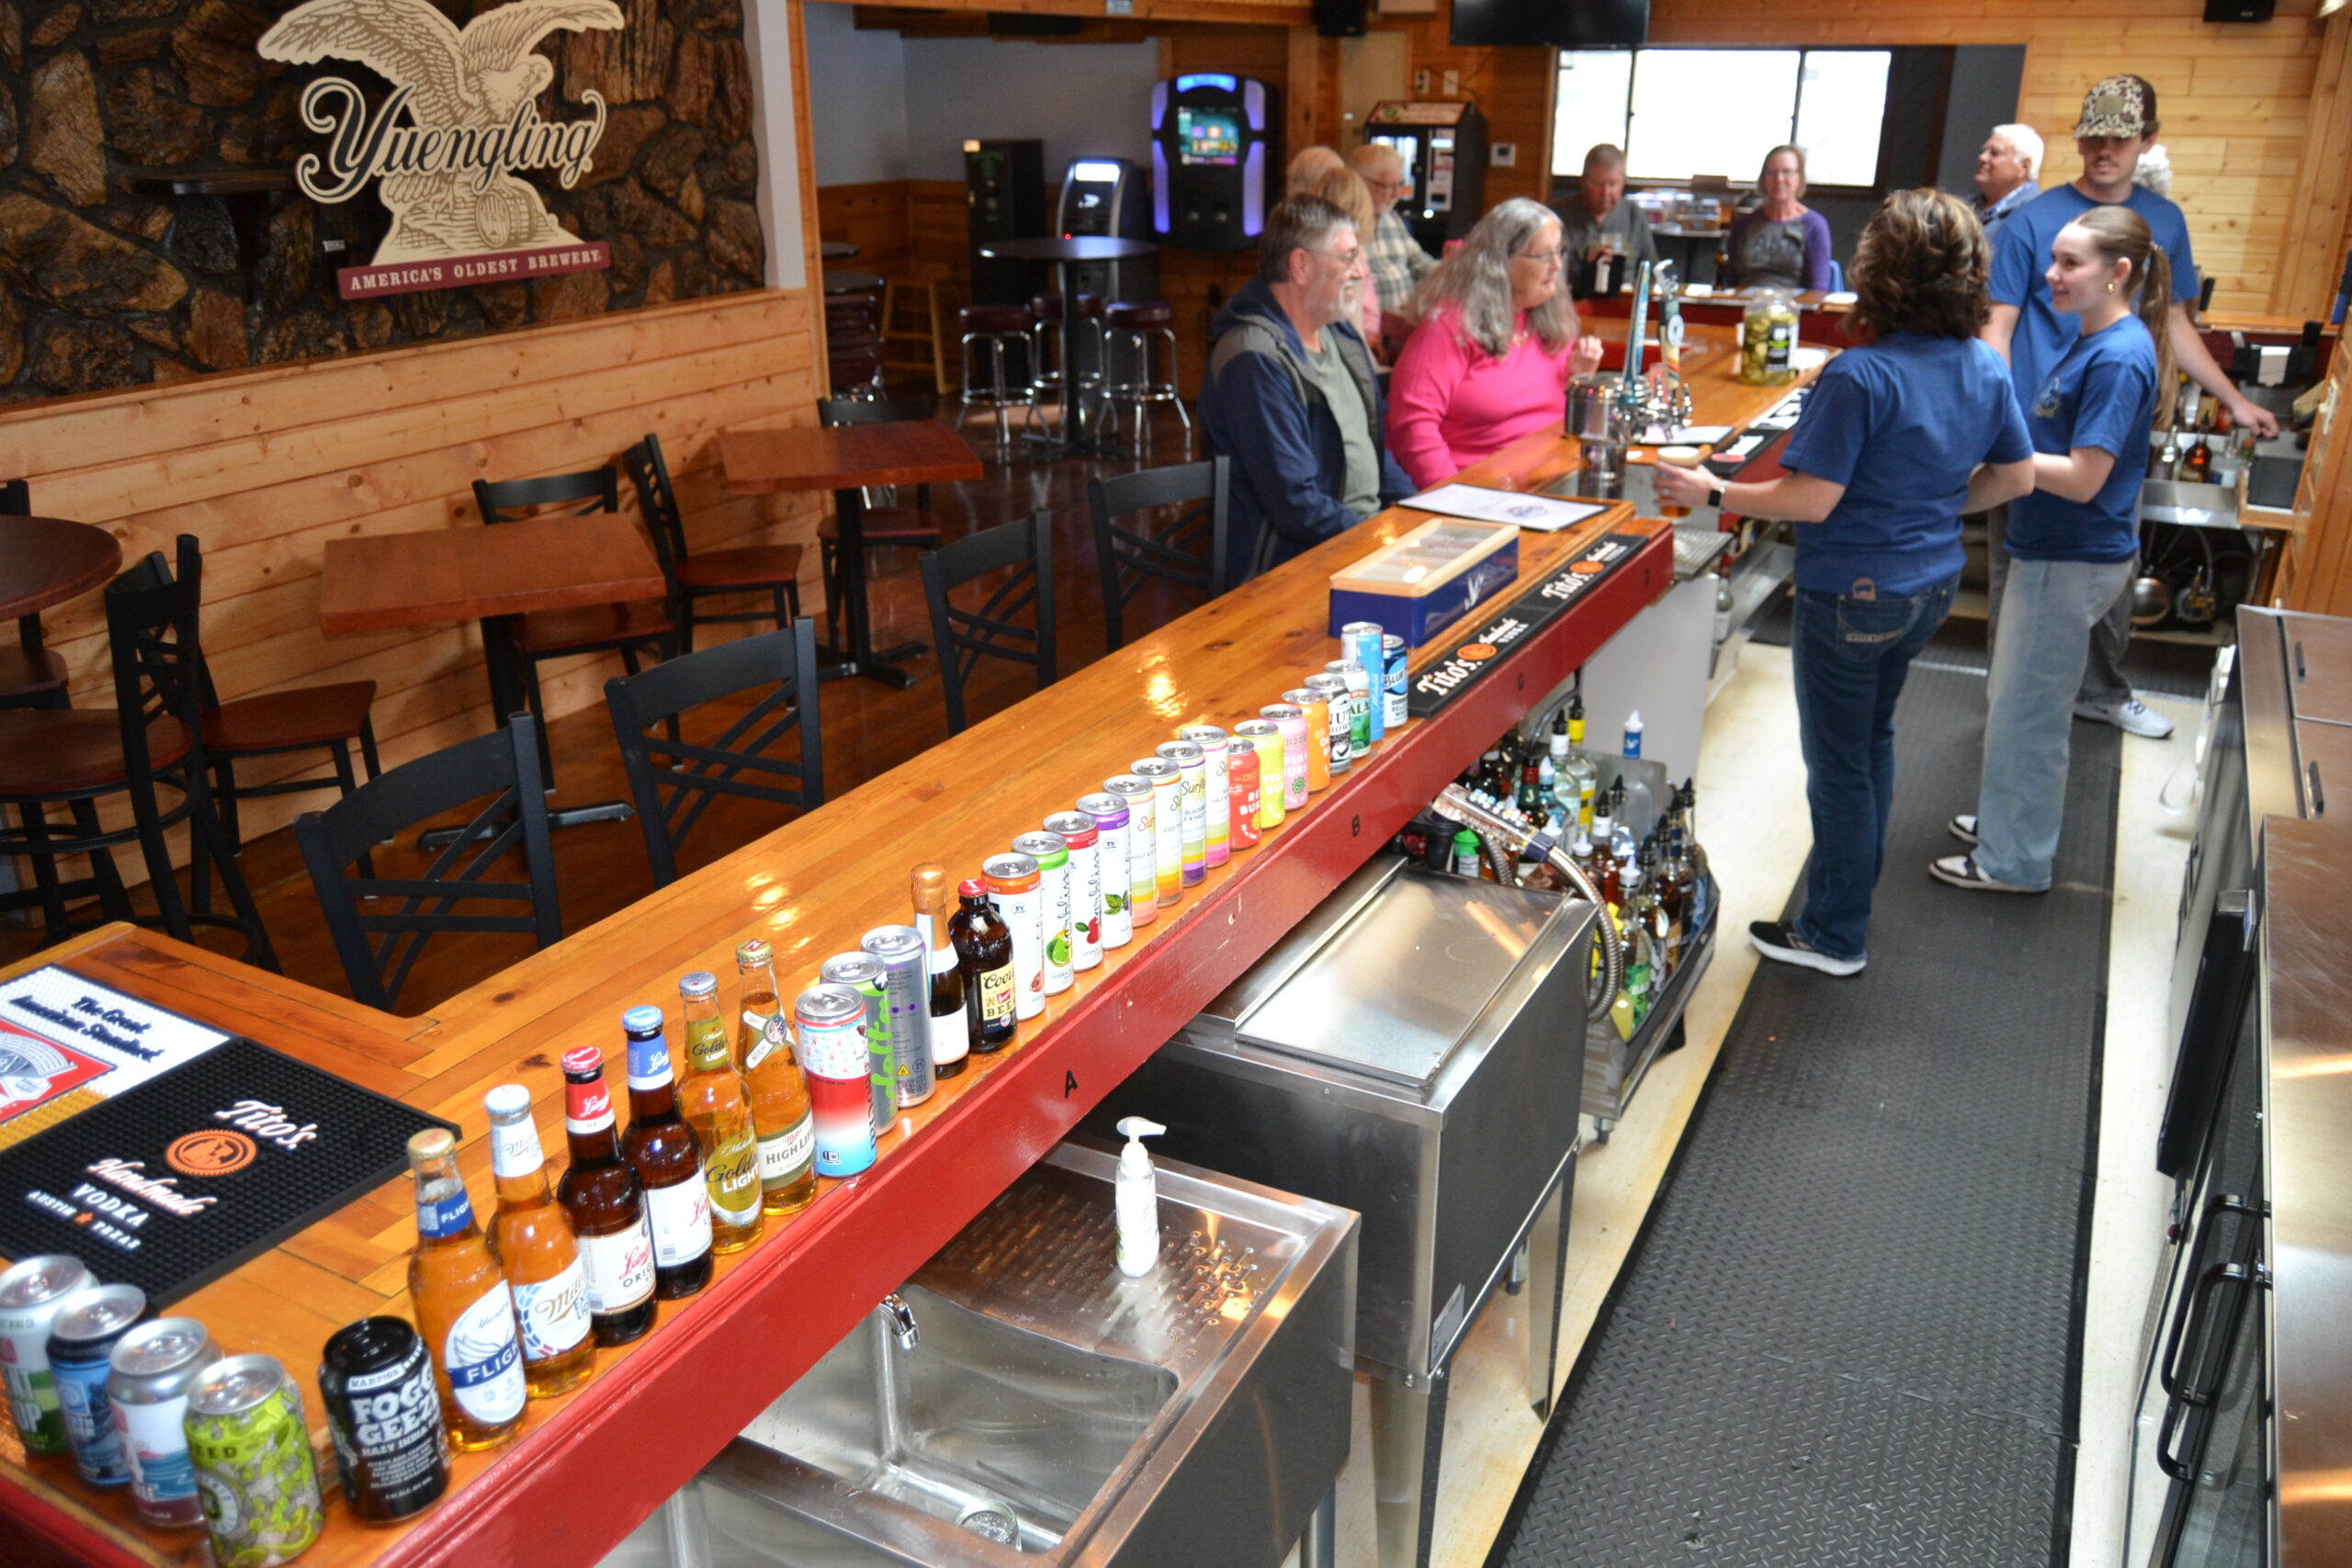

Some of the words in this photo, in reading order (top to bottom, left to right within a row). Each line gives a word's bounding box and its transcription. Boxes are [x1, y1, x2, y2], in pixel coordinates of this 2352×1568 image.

[299, 79, 604, 201] Yuengling
[351, 267, 442, 291] AMERICA'S
[454, 258, 518, 279] OLDEST
[1417, 658, 1484, 696] Tito's
[1064, 1069, 1078, 1099] A
[213, 1100, 318, 1150] Tito's
[766, 1144, 797, 1165] HIGH
[73, 1183, 150, 1227] VODKA
[86, 1158, 218, 1216] Handmade
[27, 1190, 78, 1218] AUSTIN
[91, 1221, 141, 1250] TEXAS
[467, 1340, 519, 1383] FLIGH
[350, 1354, 434, 1424] FOGG
[356, 1389, 440, 1446] GEEZ
[361, 1441, 395, 1457] HAZY
